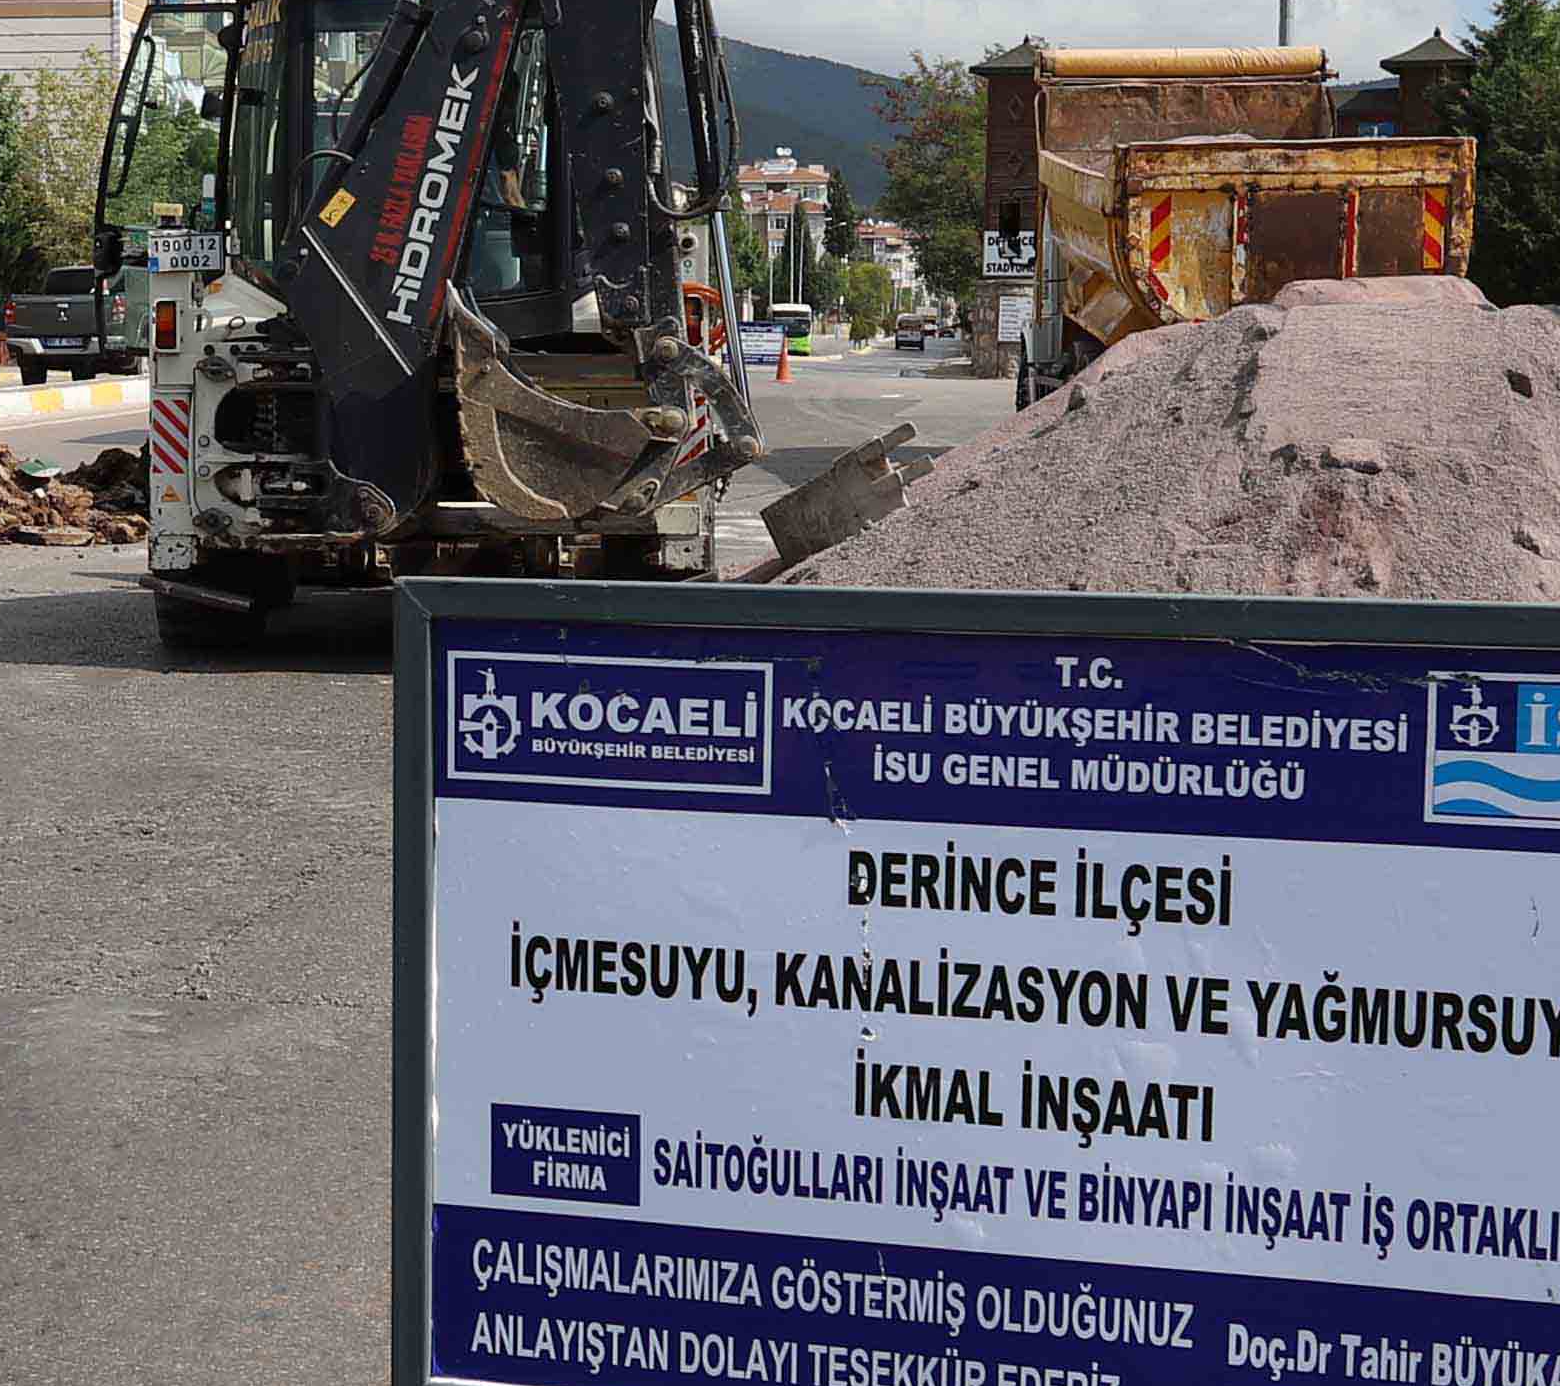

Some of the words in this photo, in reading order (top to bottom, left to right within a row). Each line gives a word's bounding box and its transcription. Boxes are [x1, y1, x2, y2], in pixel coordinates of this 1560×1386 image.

[170, 254, 210, 268] 0002
[199, 237, 217, 251] 12
[1055, 656, 1124, 689] T.C.
[531, 691, 757, 739] KOCAELİ
[783, 695, 933, 734] KOCAELİ
[944, 699, 1180, 746] BÜYÜKŞEHİR
[1191, 709, 1408, 753] BELEDİYESİ
[532, 738, 646, 761] BÜYÜKŞEHİR
[651, 744, 755, 764] BELEDİYESİ
[873, 744, 932, 784] İSU
[943, 756, 1060, 791] GENEL
[1071, 753, 1306, 800] MÜDÜRLÜĞÜ
[848, 841, 1057, 916] DERİNCE
[1075, 847, 1232, 936] İLÇESİ
[511, 920, 758, 1017] İÇMESUYU,
[774, 947, 1149, 1029] KANALİZASYON
[1165, 976, 1230, 1035] VE
[854, 1047, 1004, 1127] İKMAL
[1021, 1059, 1214, 1148] İNŞAATI
[532, 1155, 608, 1193] FİRMA
[653, 1129, 884, 1205] SAİTOĞULLARI
[896, 1146, 1015, 1222] İNŞAAT
[1024, 1169, 1067, 1219] VE
[1078, 1162, 1212, 1232] BİNYAPI
[1225, 1172, 1351, 1250] İNŞAAT
[1362, 1182, 1395, 1259] İŞ
[471, 1237, 763, 1307] ÇALIŞMALARIMIZA
[771, 1258, 966, 1336] GÖSTERMİŞ
[976, 1284, 1195, 1349] OLDUĞUNUZ
[471, 1312, 669, 1374] ANLAYIŞTAN
[679, 1332, 798, 1385] DOLAYI
[1227, 1324, 1332, 1381] Doç.Dr
[1340, 1333, 1423, 1385] Tahir
